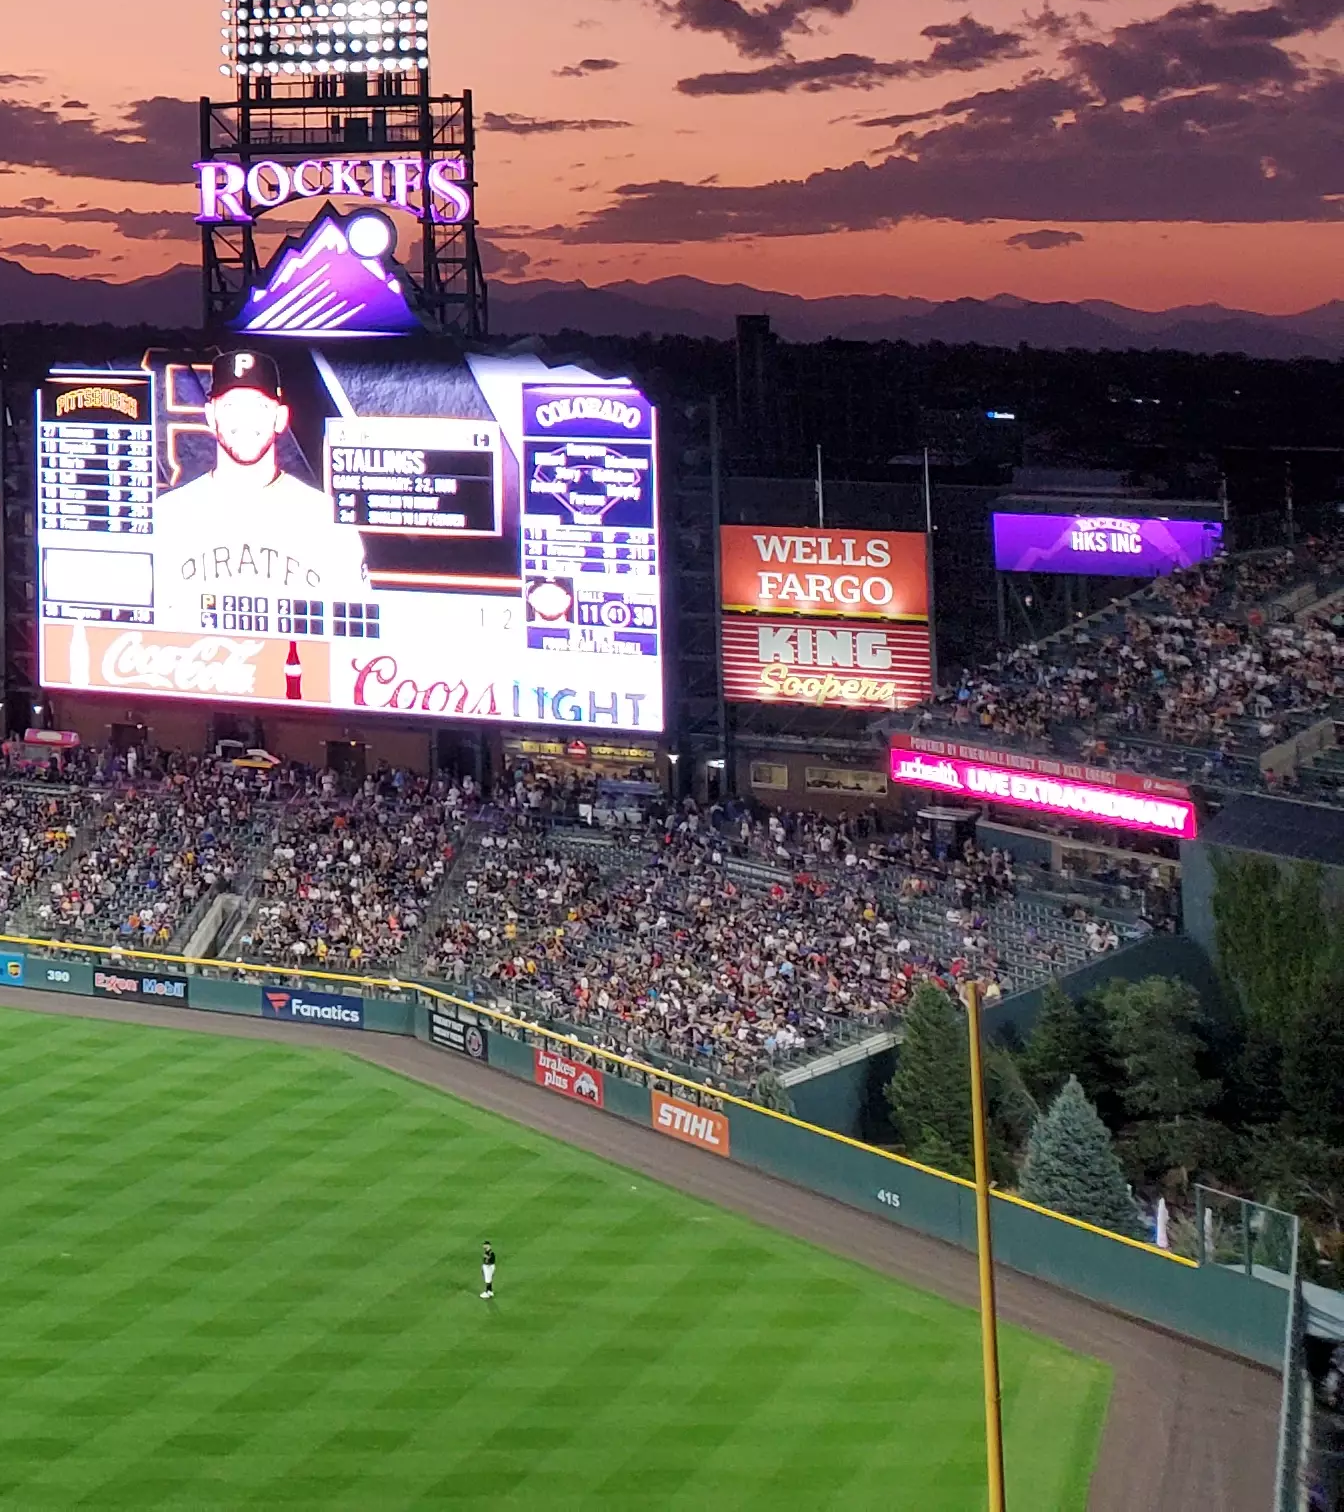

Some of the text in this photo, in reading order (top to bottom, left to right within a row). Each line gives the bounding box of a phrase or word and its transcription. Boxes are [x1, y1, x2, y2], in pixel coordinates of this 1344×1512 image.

[193, 158, 471, 224] ROCKIES
[234, 352, 255, 378] P
[56, 387, 138, 419] PITTSBURGH
[536, 397, 642, 429] COLORADO
[332, 448, 426, 475] STALLINGS
[752, 534, 892, 567] WELLS
[1072, 531, 1142, 554] HKS INC
[757, 572, 893, 605] FARGO
[580, 603, 599, 624] 11
[101, 632, 266, 694] Coca-Cola
[758, 626, 893, 669] KING
[351, 655, 502, 716] Coors
[757, 663, 897, 706] Soopers
[900, 756, 959, 786] uchealth
[967, 767, 1011, 796] LIVE
[1011, 775, 1188, 830] EXTRAORDINARY
[46, 969, 71, 983] 390
[94, 972, 186, 998] Exxon Mobil
[292, 998, 360, 1023] Fanatics
[538, 1048, 576, 1077] brakes
[543, 1071, 569, 1090] plus
[658, 1103, 720, 1145] STIHL
[877, 1189, 900, 1208] 415
